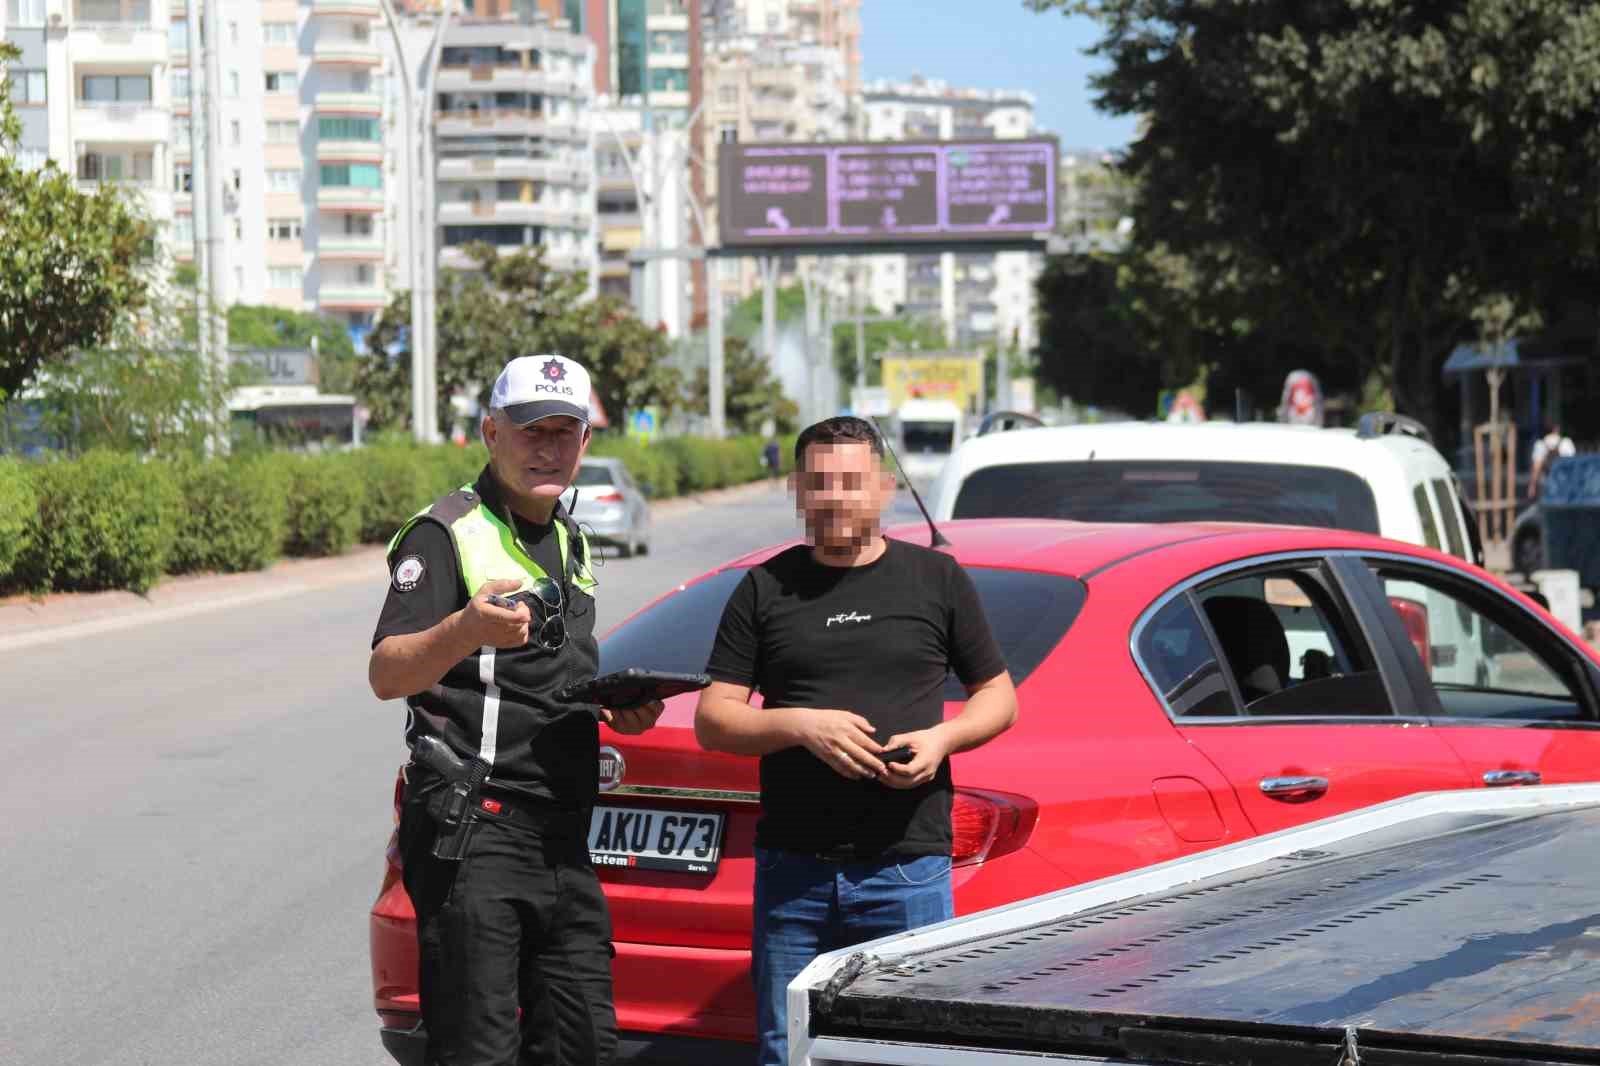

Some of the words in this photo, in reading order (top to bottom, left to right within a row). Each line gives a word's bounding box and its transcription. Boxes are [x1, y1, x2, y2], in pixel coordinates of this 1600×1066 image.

[598, 759, 615, 777] IAT
[595, 811, 651, 853] AKU
[657, 815, 716, 858] 673
